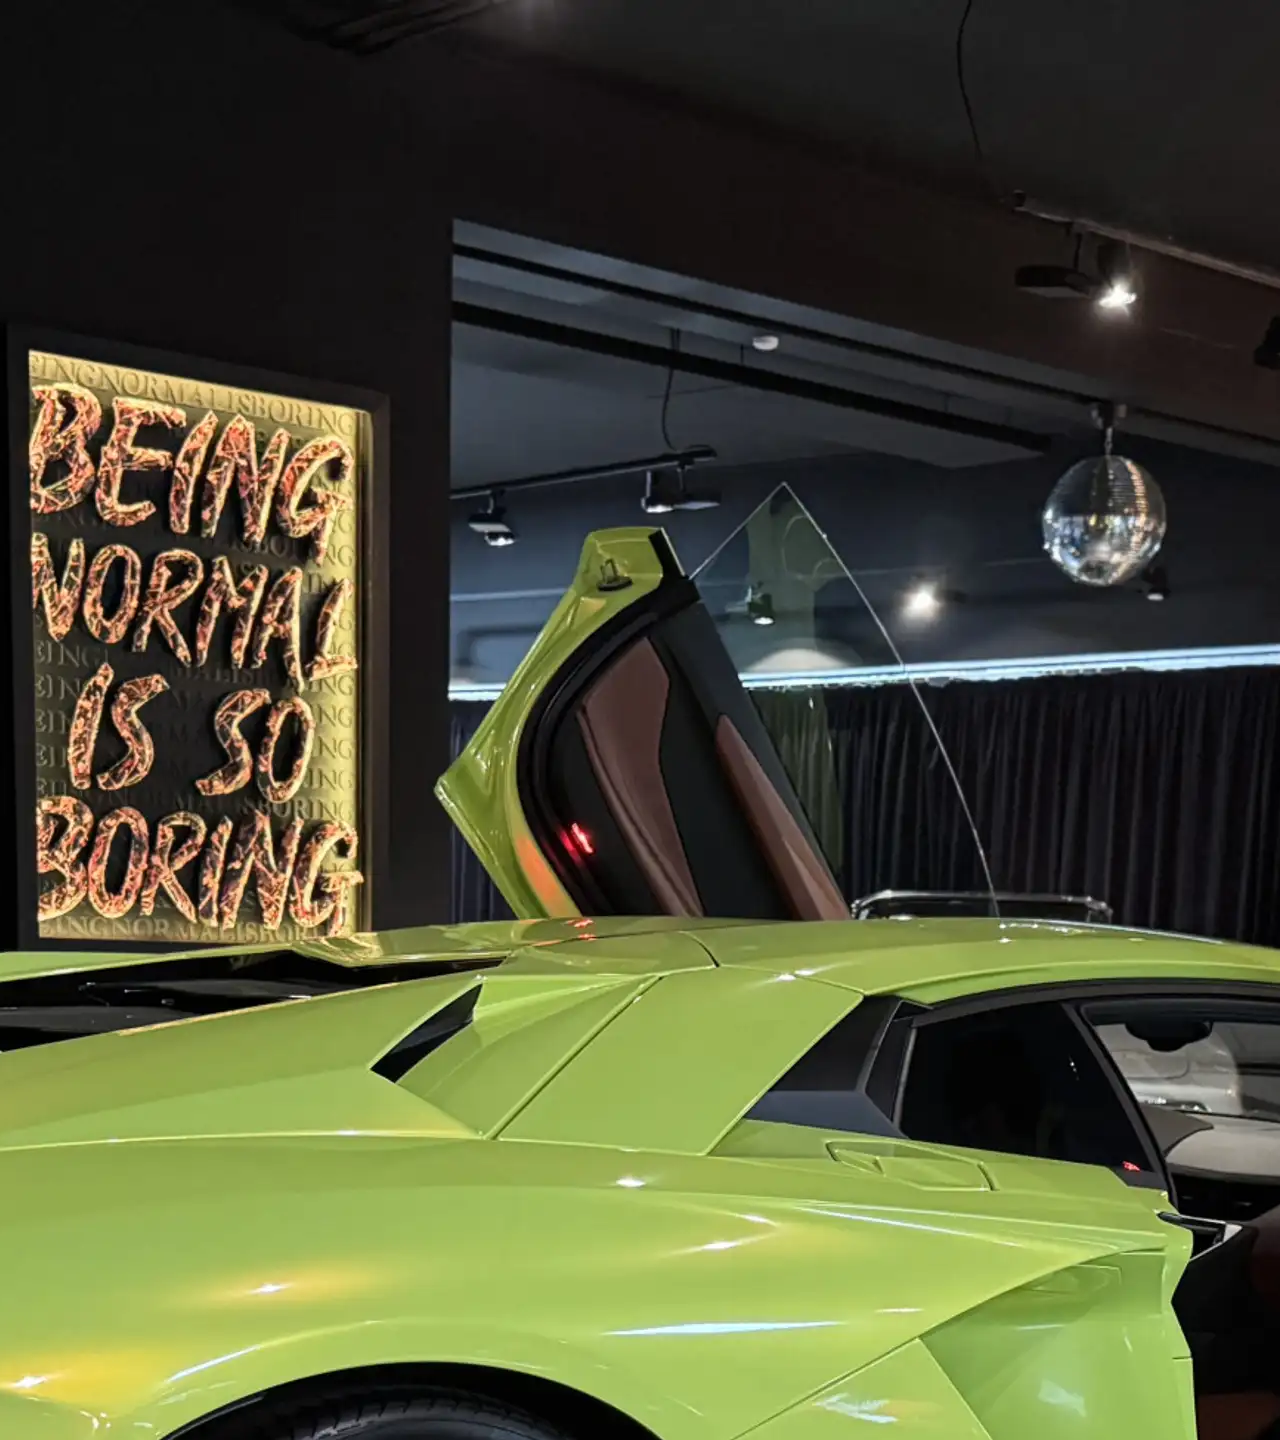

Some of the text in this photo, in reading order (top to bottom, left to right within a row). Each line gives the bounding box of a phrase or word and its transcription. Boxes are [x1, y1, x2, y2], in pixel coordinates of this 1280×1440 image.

[29, 382, 354, 565] BEING
[31, 531, 358, 695] NORMAL
[68, 662, 170, 790] IS
[195, 688, 317, 803] SO
[36, 795, 364, 937] BORING
